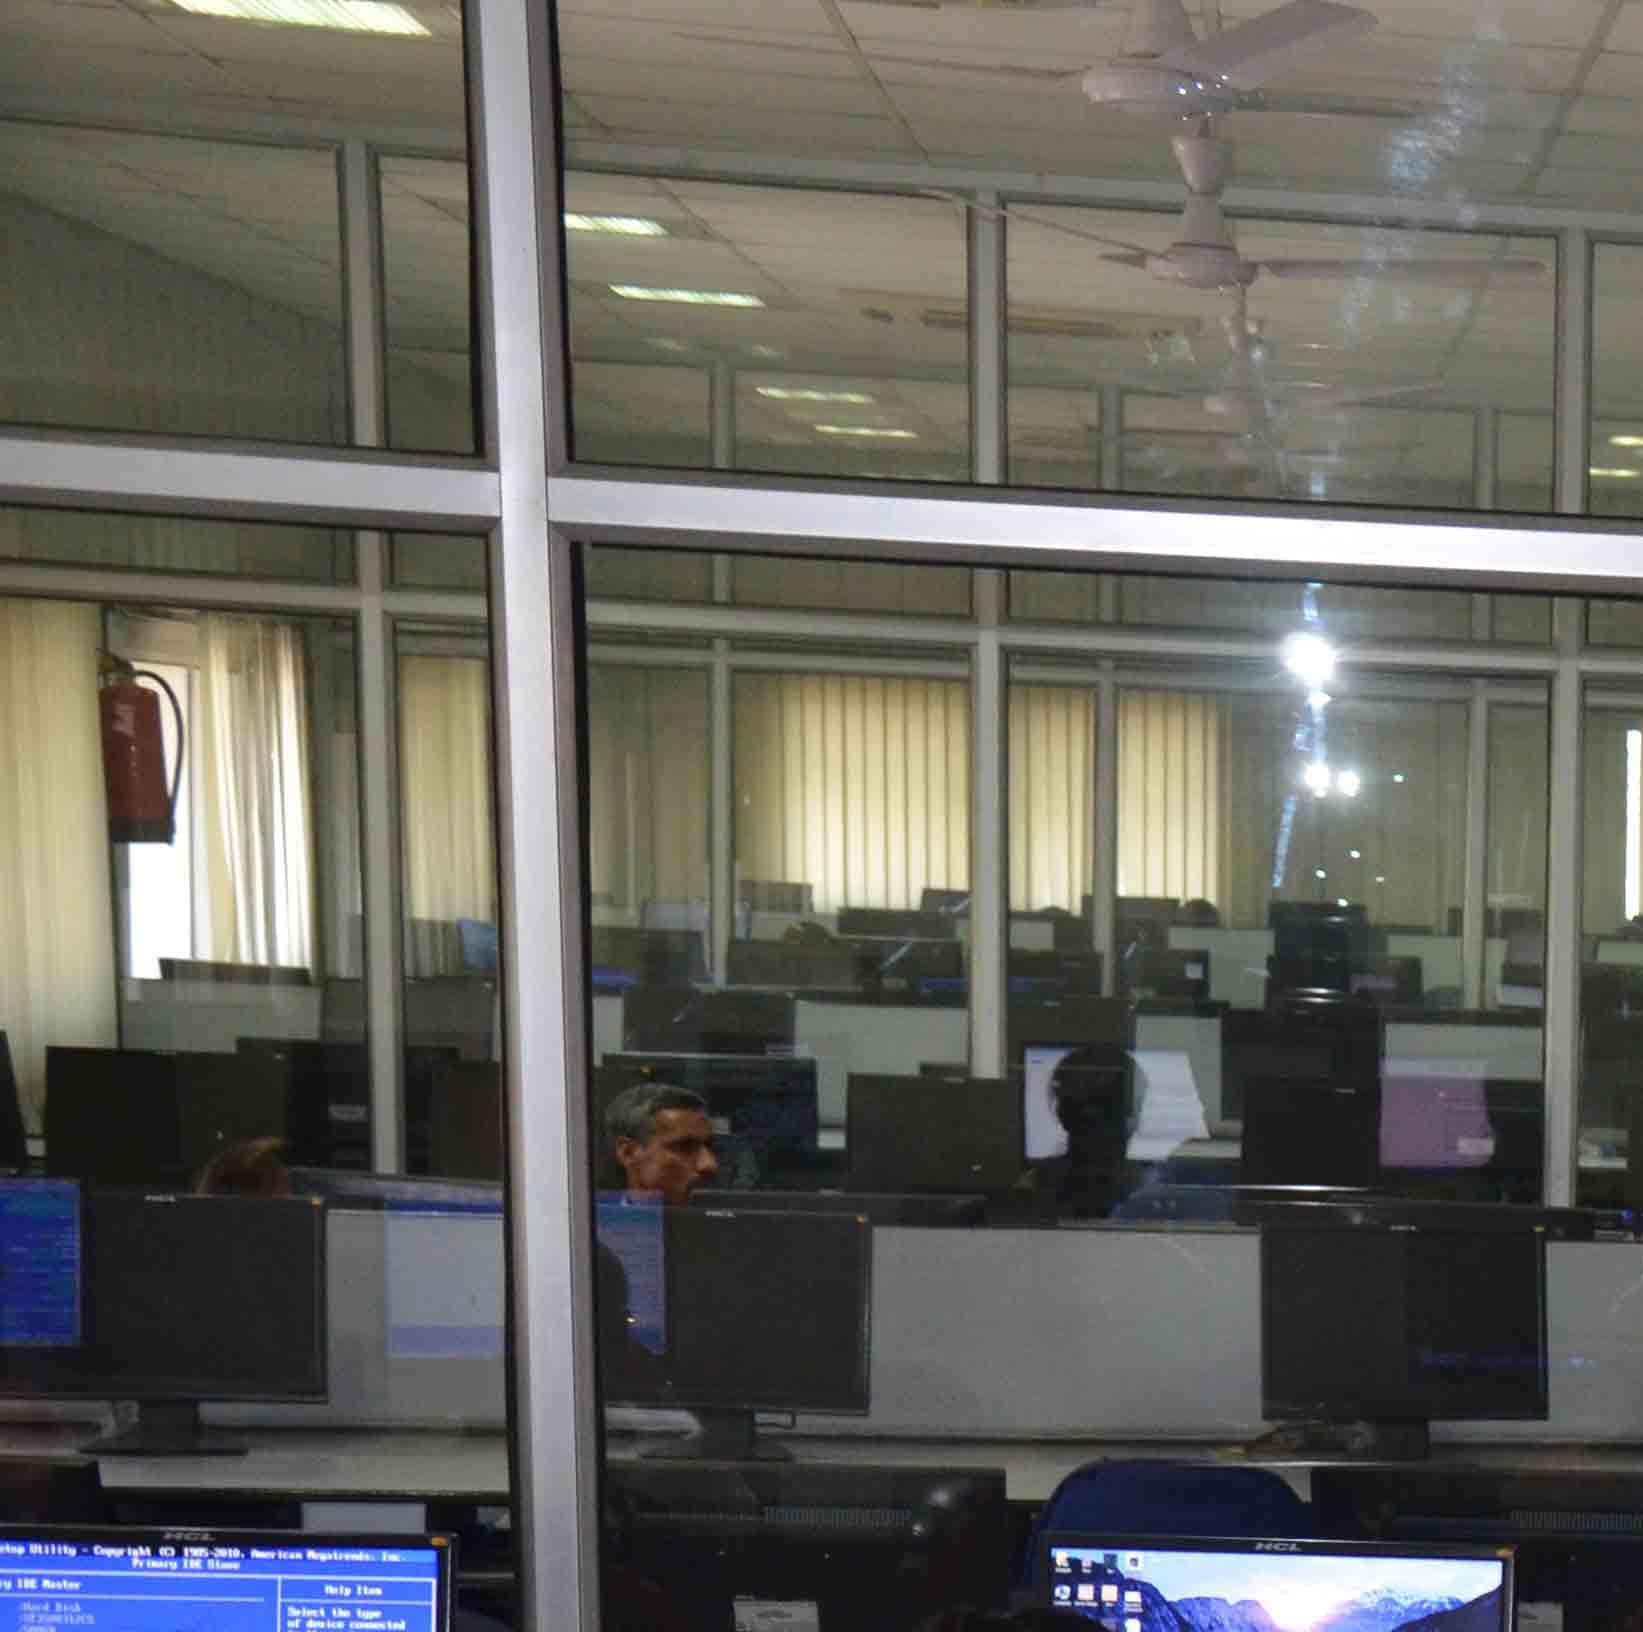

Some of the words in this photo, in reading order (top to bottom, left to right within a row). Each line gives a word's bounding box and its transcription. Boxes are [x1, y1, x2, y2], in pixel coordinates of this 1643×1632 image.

[29, 1543, 77, 1558] Utility
[93, 1545, 152, 1559] Copyright
[251, 1549, 303, 1561] American
[1254, 1542, 1302, 1552] HCL
[132, 1558, 178, 1571] Primary
[41, 1579, 81, 1590] Master
[324, 1585, 352, 1597] Help
[356, 1586, 383, 1596] Item
[287, 1606, 325, 1617] Select
[332, 1607, 351, 1617] the
[356, 1608, 383, 1619] type
[287, 1618, 302, 1629] of
[305, 1619, 345, 1630] device
[349, 1620, 406, 1631] connected
